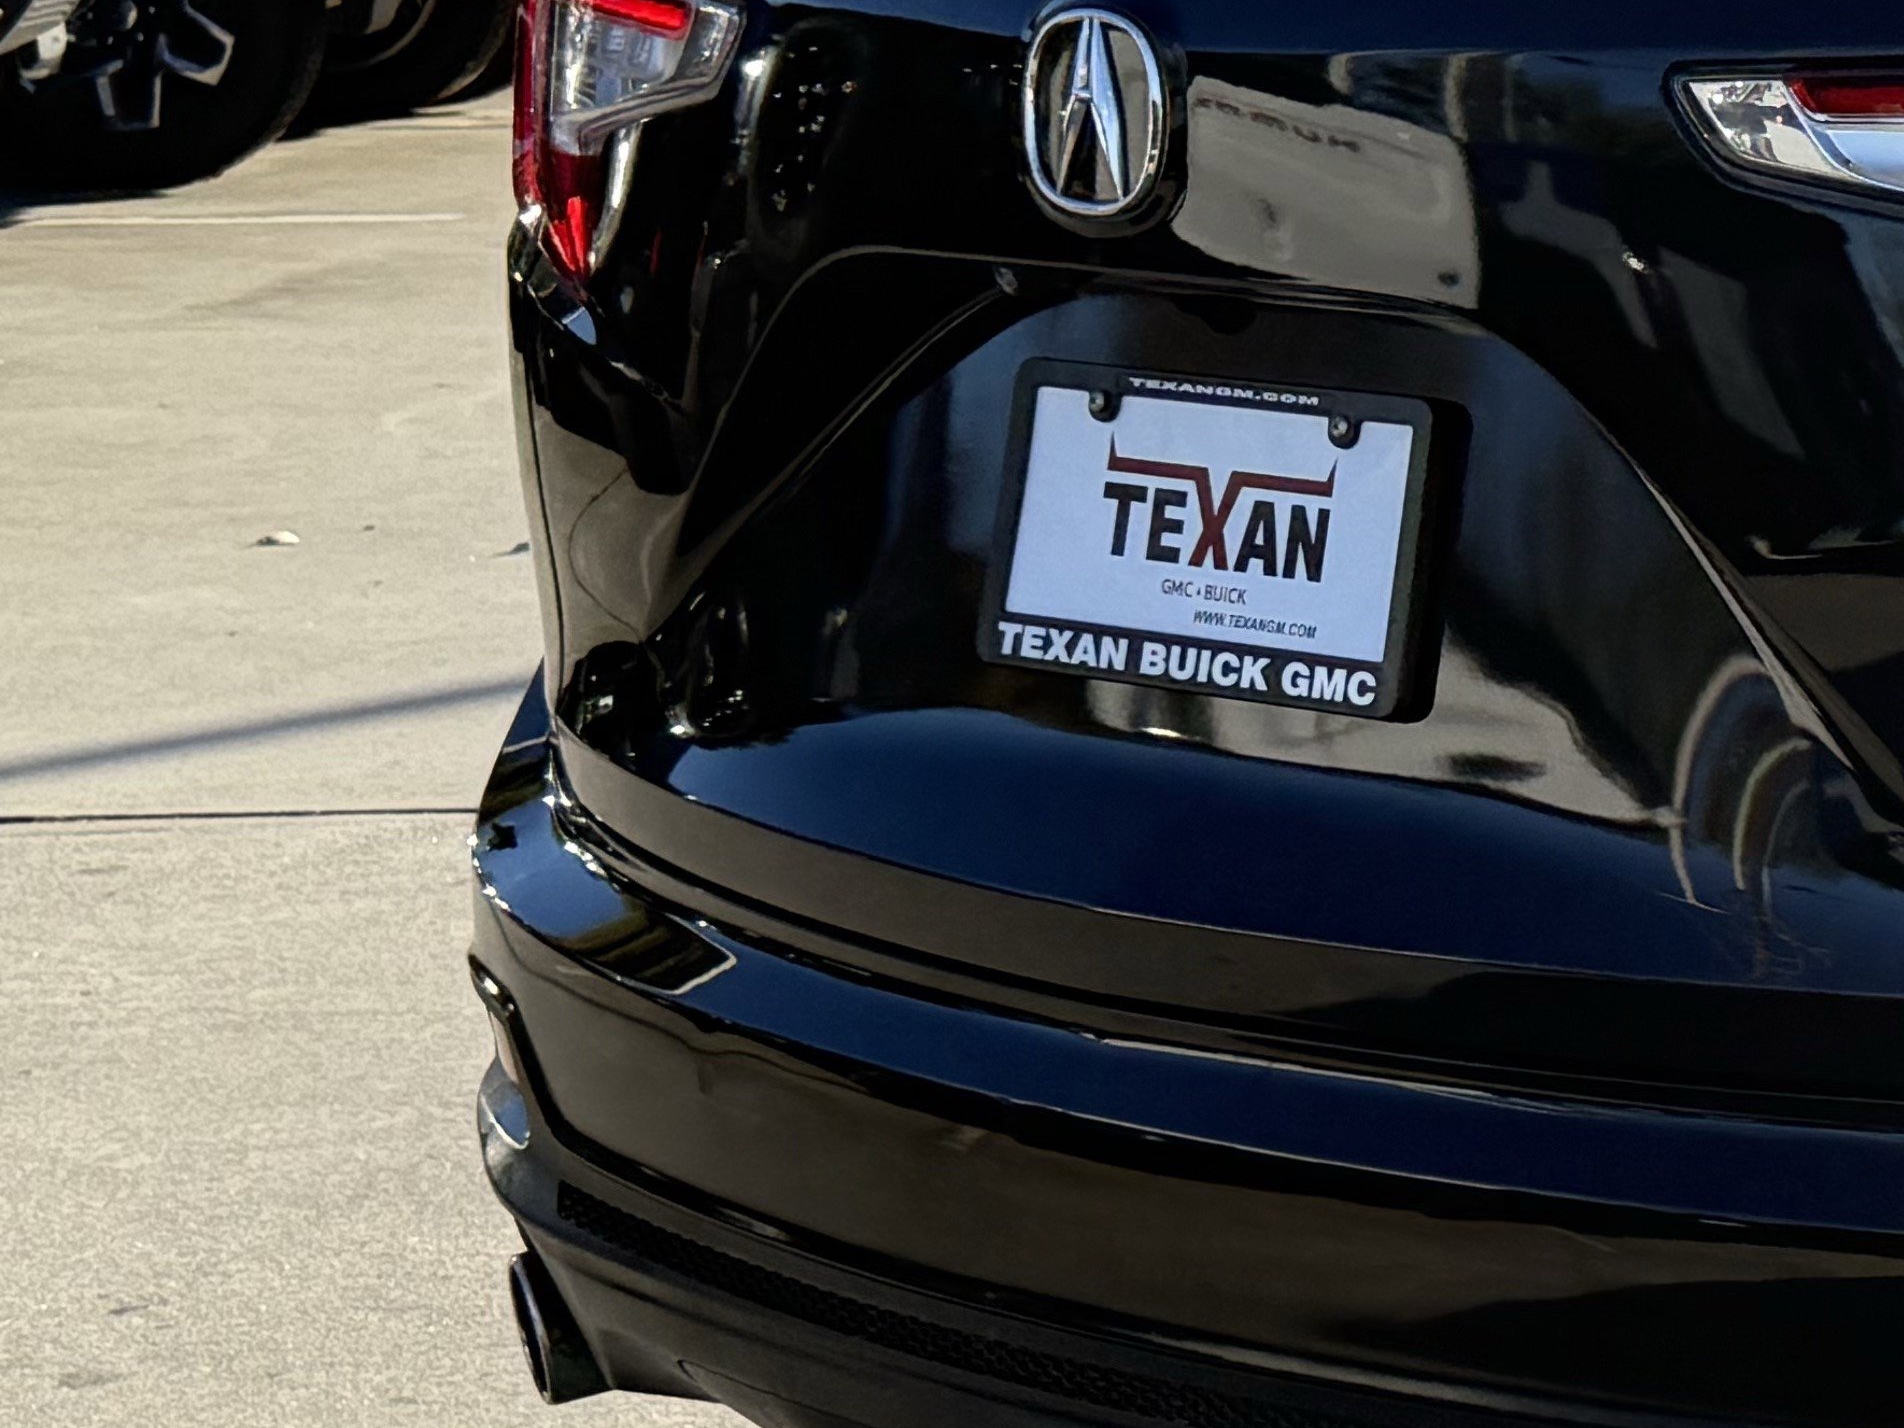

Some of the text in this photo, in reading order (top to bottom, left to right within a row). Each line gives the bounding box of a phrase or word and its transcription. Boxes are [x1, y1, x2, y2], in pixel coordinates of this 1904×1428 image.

[1103, 432, 1339, 583] TEXAN
[1161, 578, 1248, 605] GMC BUICK
[998, 621, 1378, 707] TEXAN BUICK GMC
